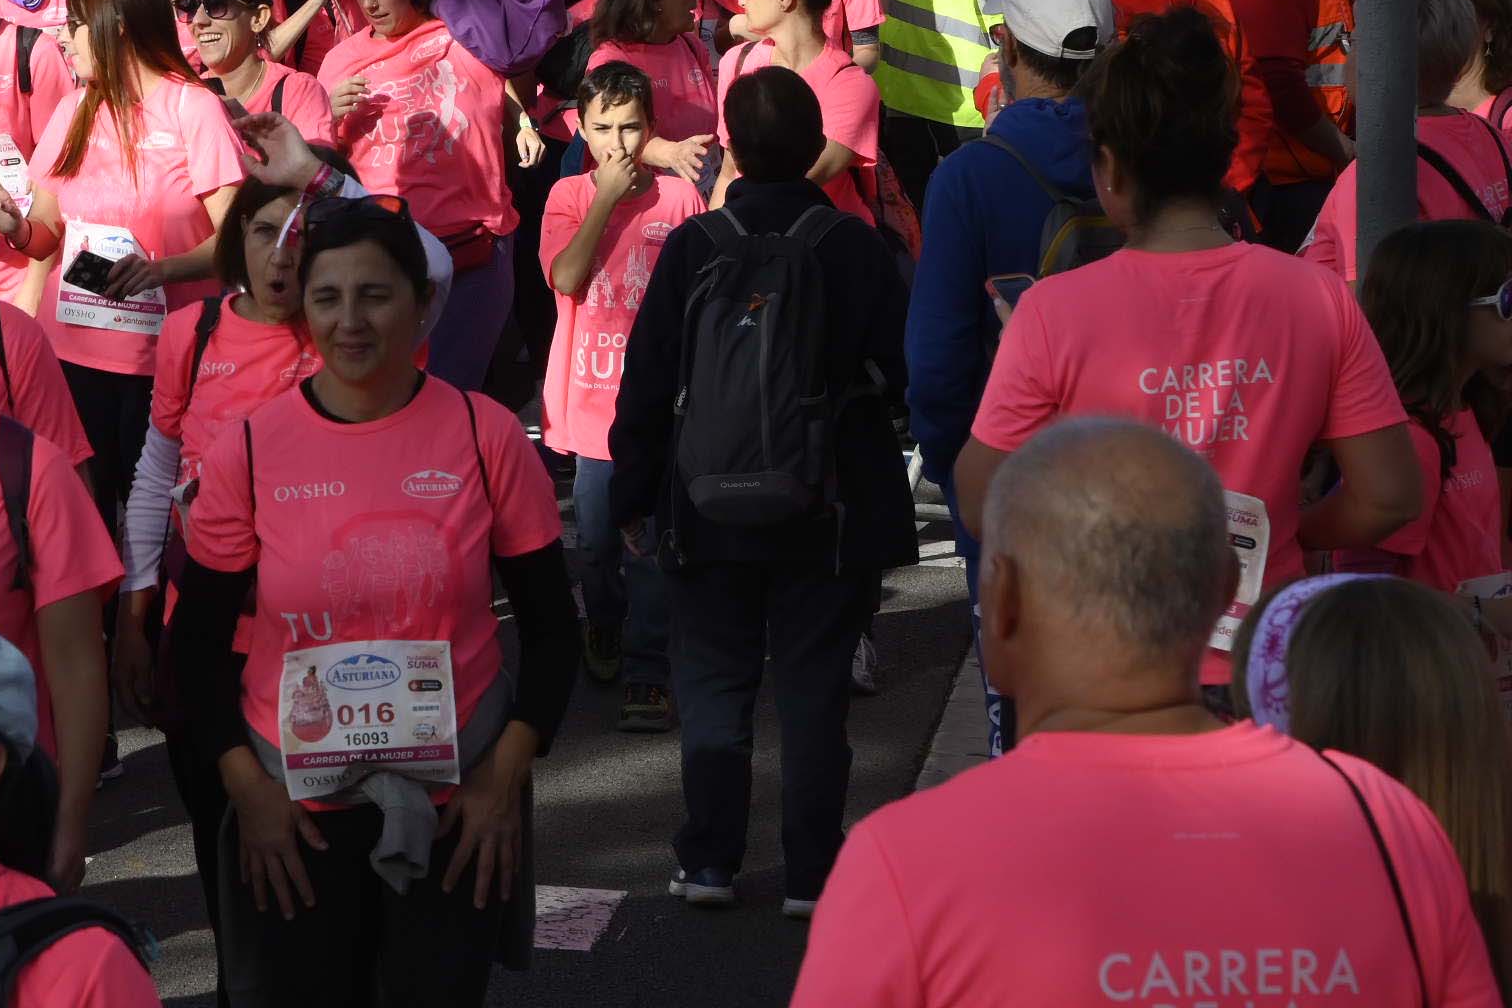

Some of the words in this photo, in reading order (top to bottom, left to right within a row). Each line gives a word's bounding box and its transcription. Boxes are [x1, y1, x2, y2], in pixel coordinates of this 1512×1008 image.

[69, 294, 97, 304] CARRERA
[1139, 357, 1273, 394] CARRERA
[1165, 392, 1201, 420] DE
[1212, 390, 1244, 416] LA
[274, 481, 345, 502] OYSHO
[281, 612, 333, 641] TU
[407, 660, 439, 670] SUMA
[332, 669, 396, 683] ASTURIANA
[337, 702, 396, 726] 016
[345, 731, 389, 746] 16093
[302, 756, 347, 766] CARRERA
[364, 753, 377, 762] LA
[380, 751, 414, 760] MUJER
[1098, 947, 1360, 1001] CARRERA
